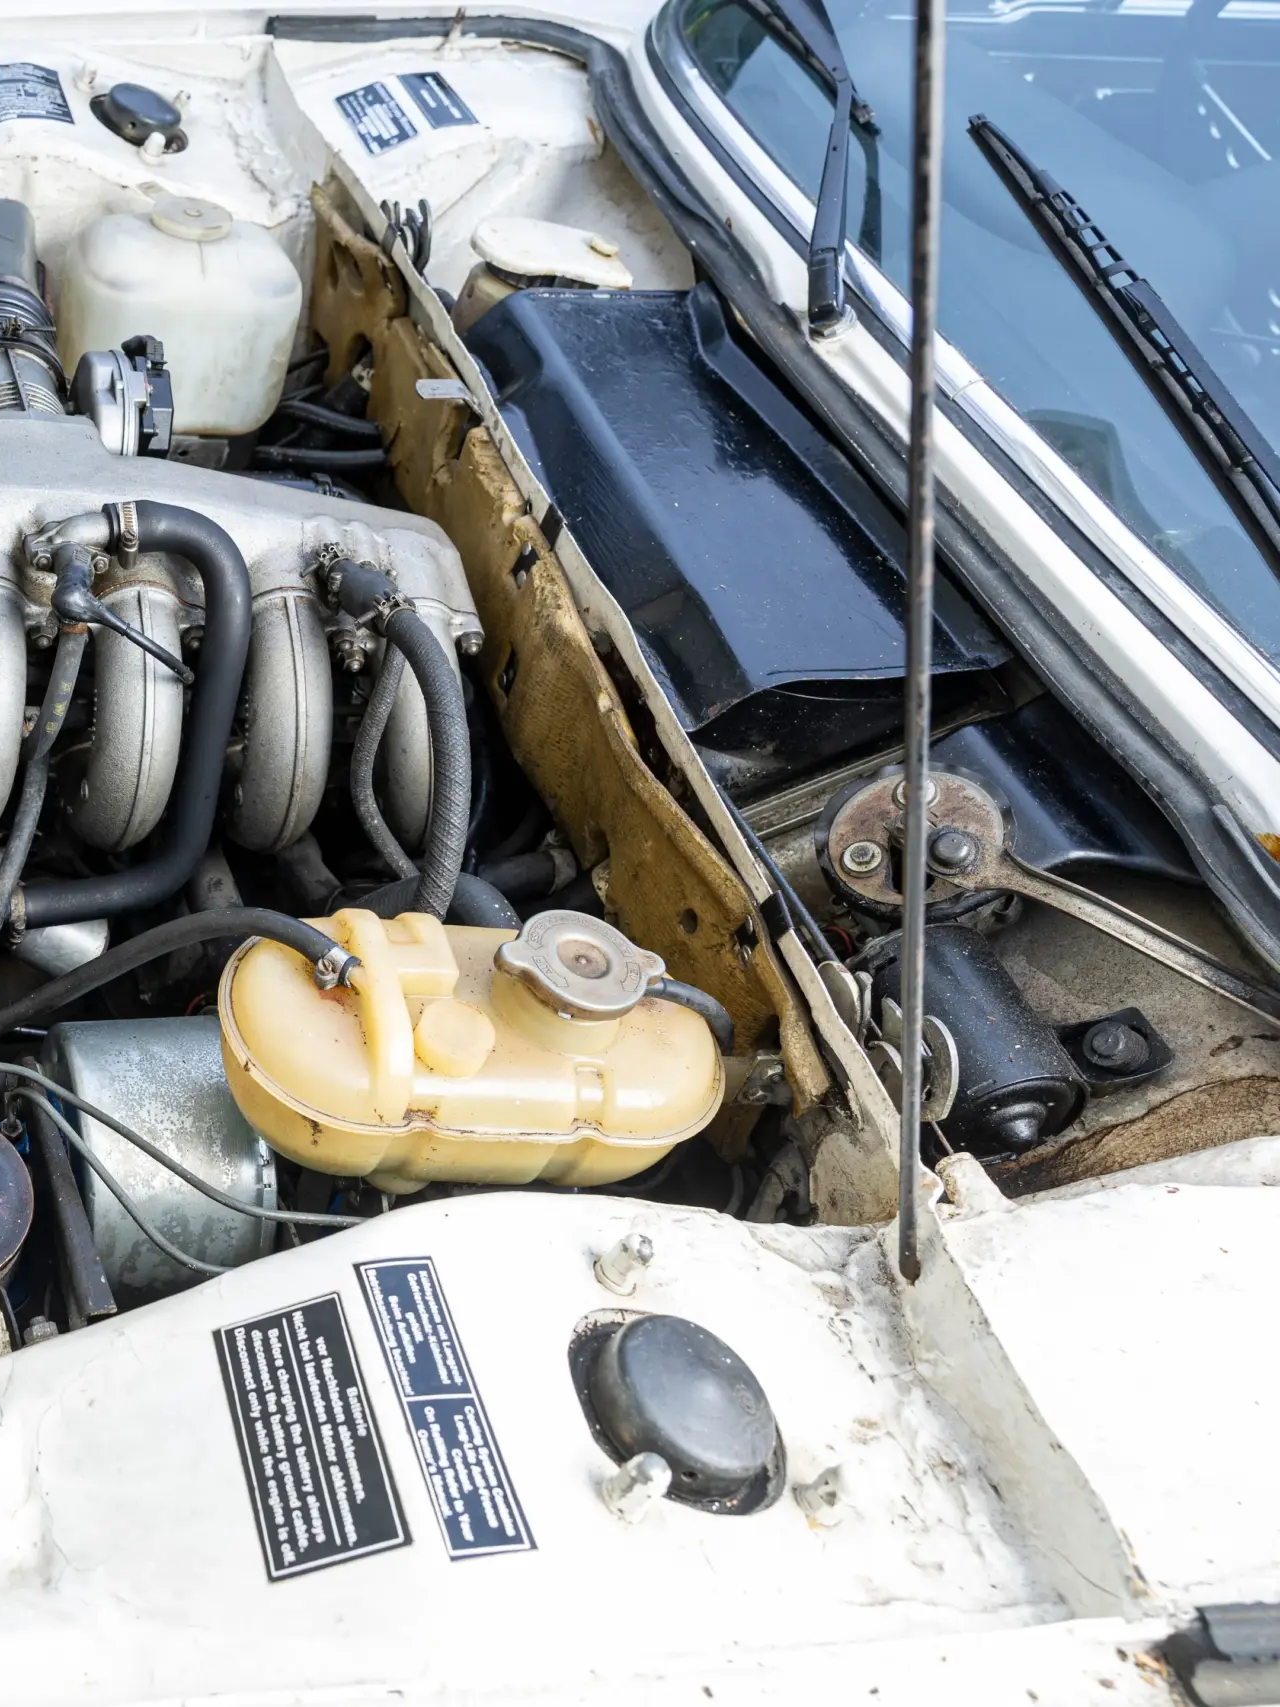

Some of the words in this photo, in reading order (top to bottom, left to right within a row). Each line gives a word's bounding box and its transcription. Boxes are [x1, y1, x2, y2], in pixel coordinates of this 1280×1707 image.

[292, 1310, 307, 1340] Nicht
[234, 1327, 256, 1389] Disconnect
[251, 1329, 273, 1391] disconnect
[267, 1328, 283, 1366] Before
[299, 1340, 313, 1360] bei
[248, 1391, 261, 1417] only
[265, 1391, 277, 1412] the
[277, 1368, 296, 1422] charging
[346, 1386, 367, 1436] Batterie
[423, 1406, 435, 1422] On
[254, 1420, 269, 1453] while
[270, 1414, 286, 1458] battery
[289, 1423, 302, 1444] the
[315, 1336, 327, 1355] vor
[321, 1357, 344, 1422] Nachladen
[338, 1425, 364, 1503] abklemmen.
[453, 1414, 476, 1463] Long-Life
[320, 1423, 336, 1461] Motor
[262, 1455, 273, 1476] the
[278, 1461, 301, 1508] ground
[295, 1446, 313, 1491] battery
[464, 1405, 483, 1445] Cooling
[478, 1446, 497, 1486] System
[491, 1487, 515, 1536] Contains
[267, 1479, 284, 1524] engine
[306, 1495, 325, 1542] always
[330, 1465, 356, 1545] abklemmen.
[453, 1499, 464, 1513] to
[277, 1526, 288, 1541] is
[292, 1510, 308, 1551] cable.
[458, 1513, 474, 1541] Your
[280, 1542, 295, 1565] off.
